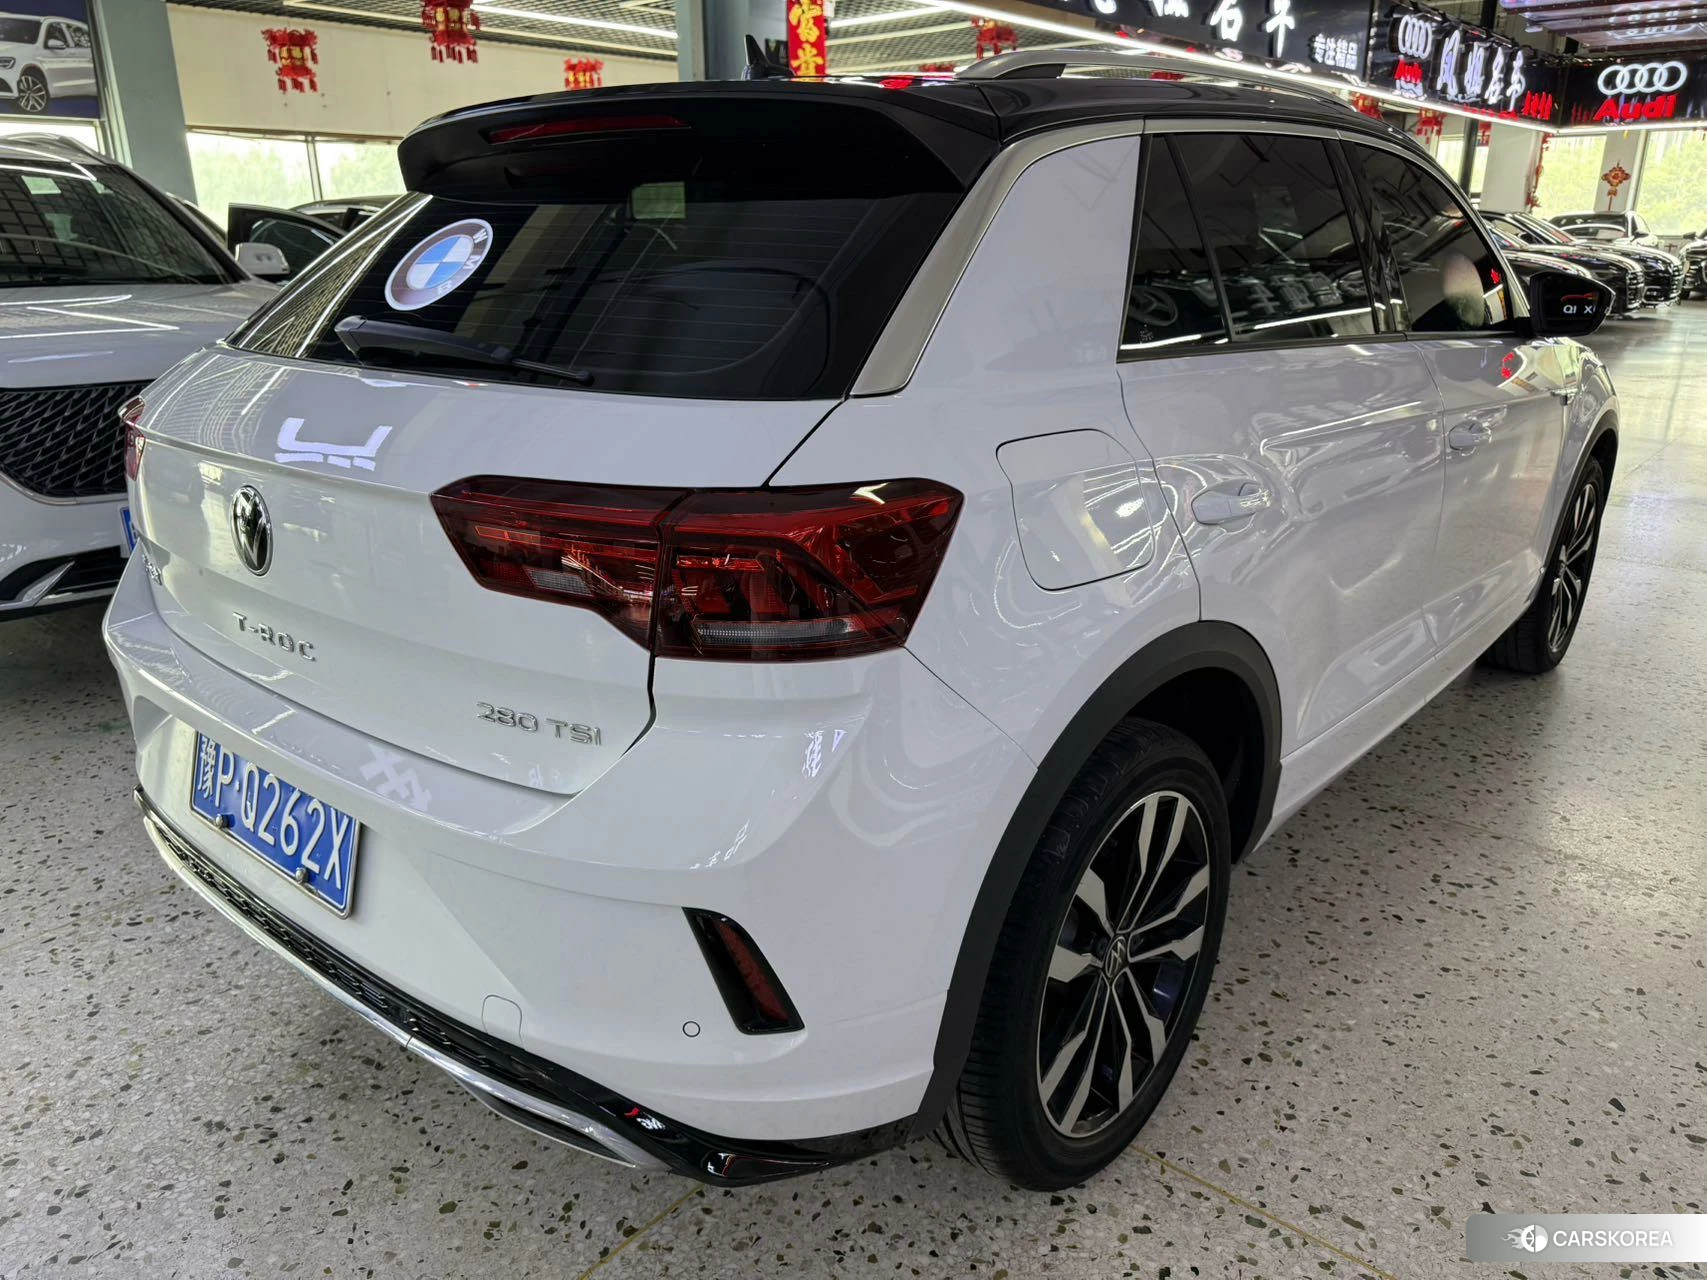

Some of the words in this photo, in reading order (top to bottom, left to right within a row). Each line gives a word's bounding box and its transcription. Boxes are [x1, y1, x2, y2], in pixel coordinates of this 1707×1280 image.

[1593, 93, 1679, 121] Audi
[232, 612, 317, 662] T-ROC
[476, 701, 540, 733] 280
[545, 717, 603, 746] TSI
